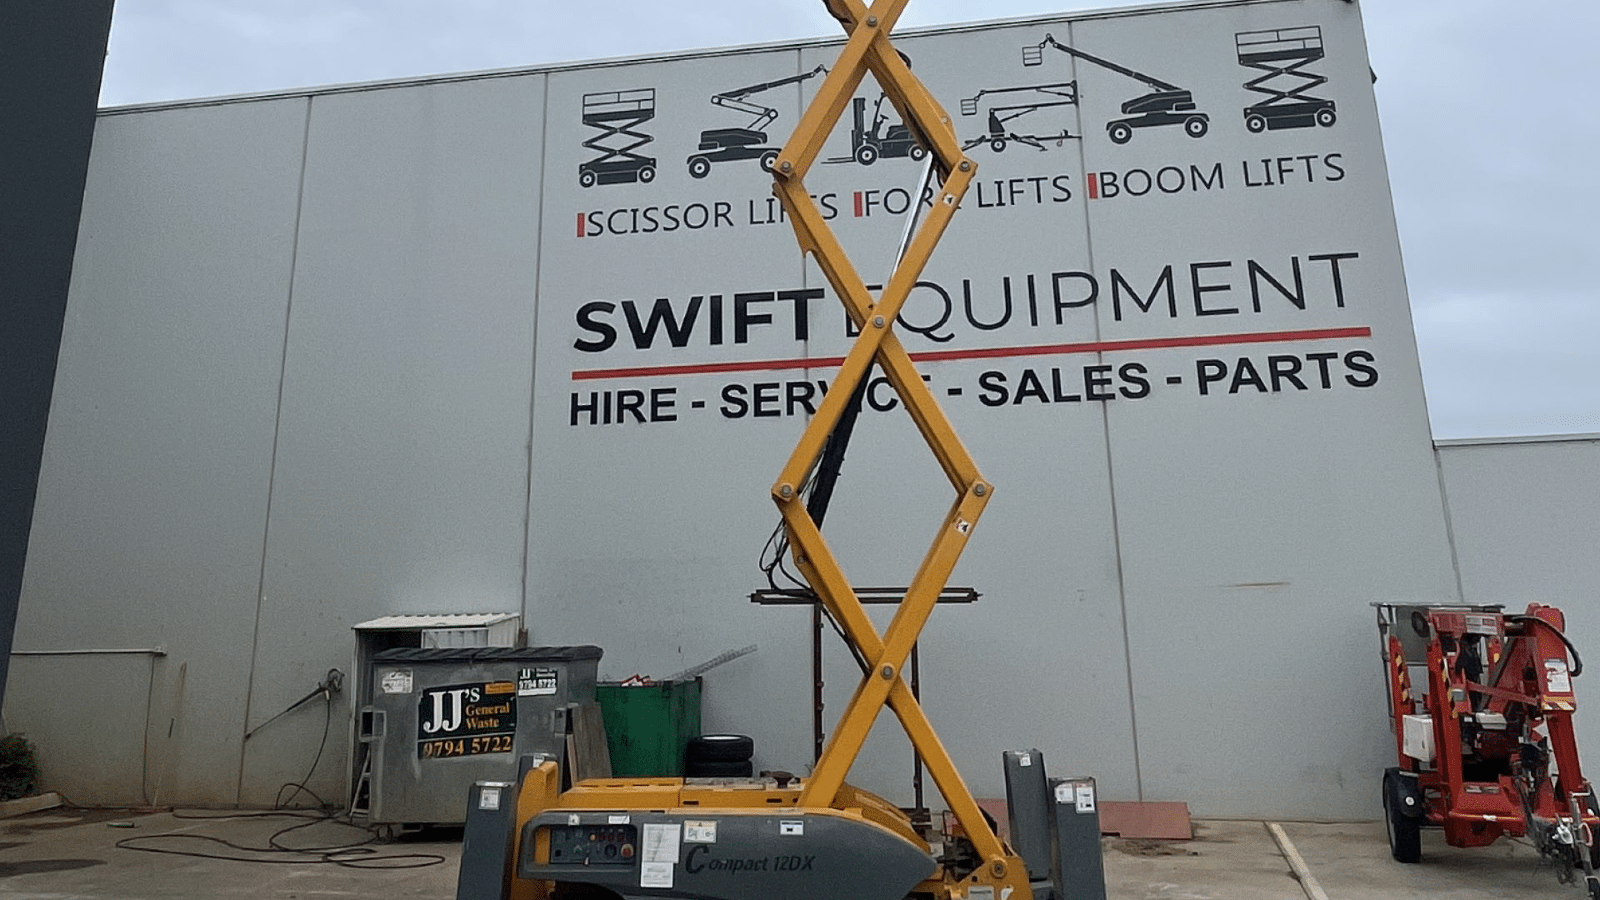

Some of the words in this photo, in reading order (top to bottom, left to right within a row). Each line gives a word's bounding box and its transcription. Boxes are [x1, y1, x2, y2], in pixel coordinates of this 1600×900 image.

[587, 201, 734, 237] SCISSOR
[865, 187, 963, 217] FOR
[977, 175, 1072, 208] LIFTS
[1099, 163, 1225, 199] BOOM
[1242, 153, 1346, 187] LIFTS
[573, 287, 825, 353] SWIFT
[570, 387, 678, 426] HIRE
[719, 374, 931, 419] SERC
[977, 362, 1151, 407] SALES
[1196, 350, 1379, 396] PARTS
[465, 701, 511, 717] General
[465, 717, 500, 730] Waste
[423, 739, 465, 758] 9794
[471, 735, 512, 754] 5722
[685, 844, 768, 876] Compact
[773, 855, 817, 871] 12DX
